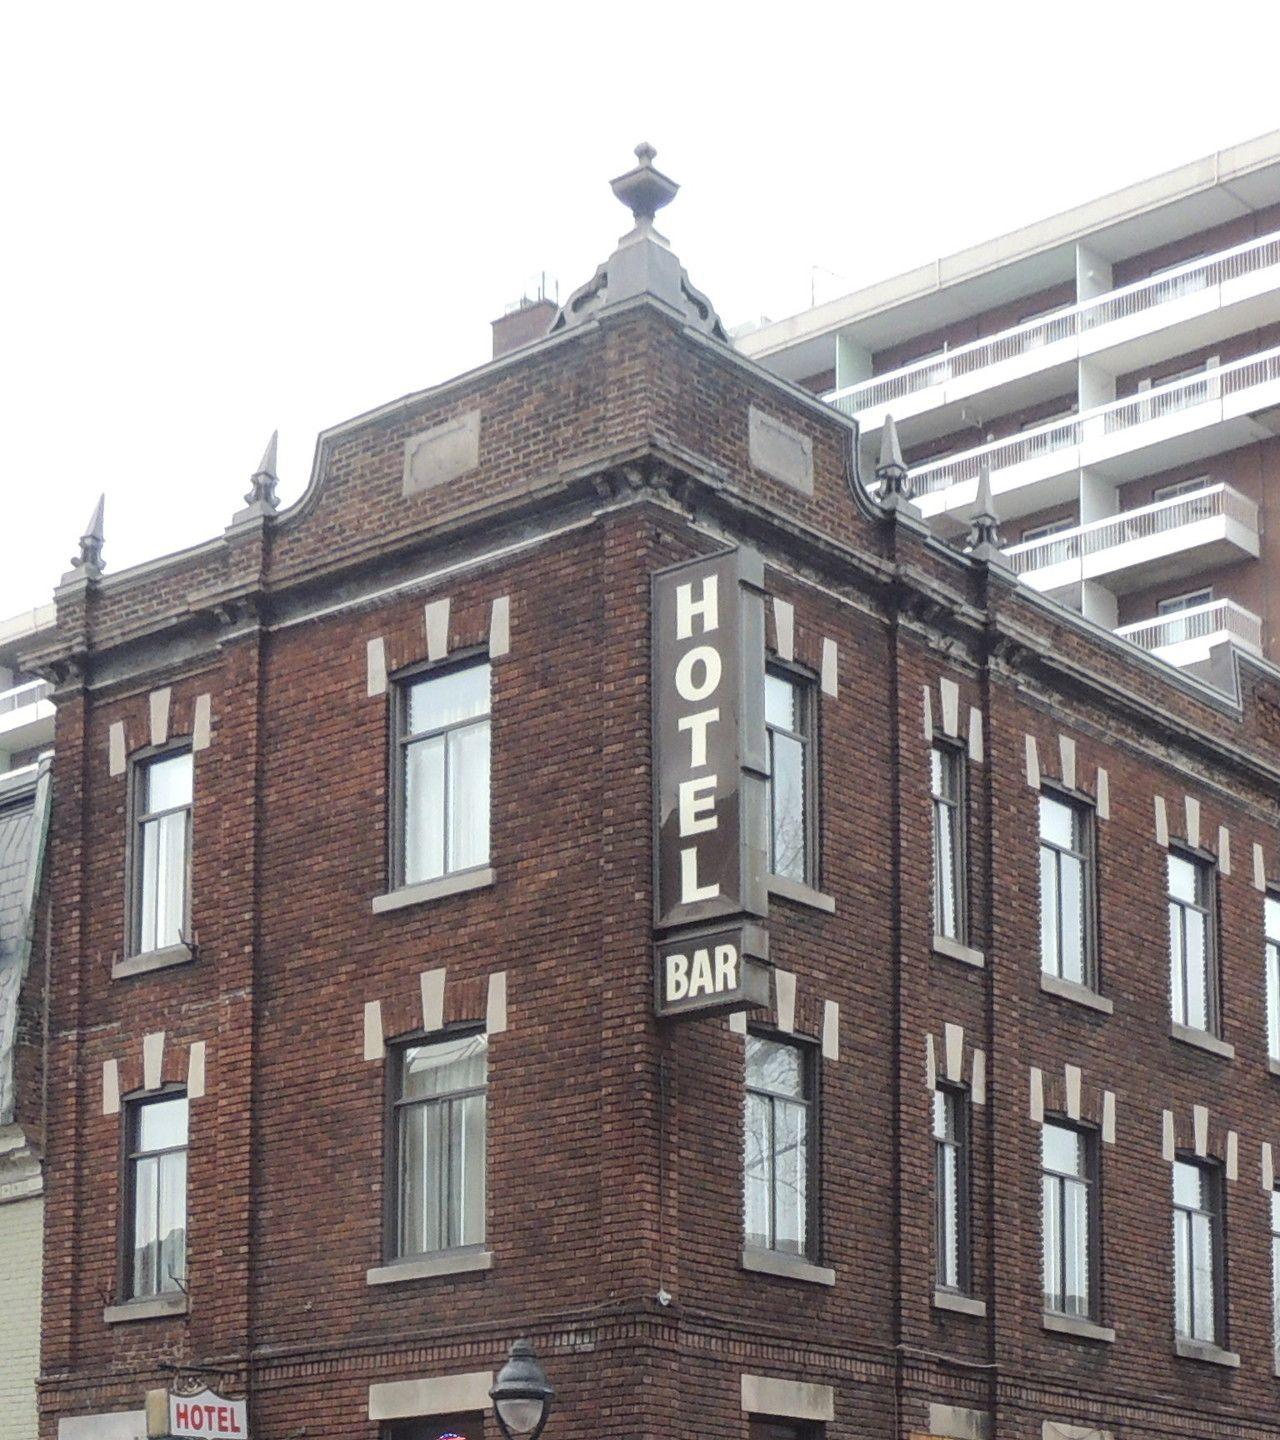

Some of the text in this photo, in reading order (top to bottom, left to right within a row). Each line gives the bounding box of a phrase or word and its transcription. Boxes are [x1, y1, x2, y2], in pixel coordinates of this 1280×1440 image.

[675, 574, 722, 905] HOTEL
[665, 944, 738, 1002] BAR
[176, 1403, 241, 1433] HOTEL
